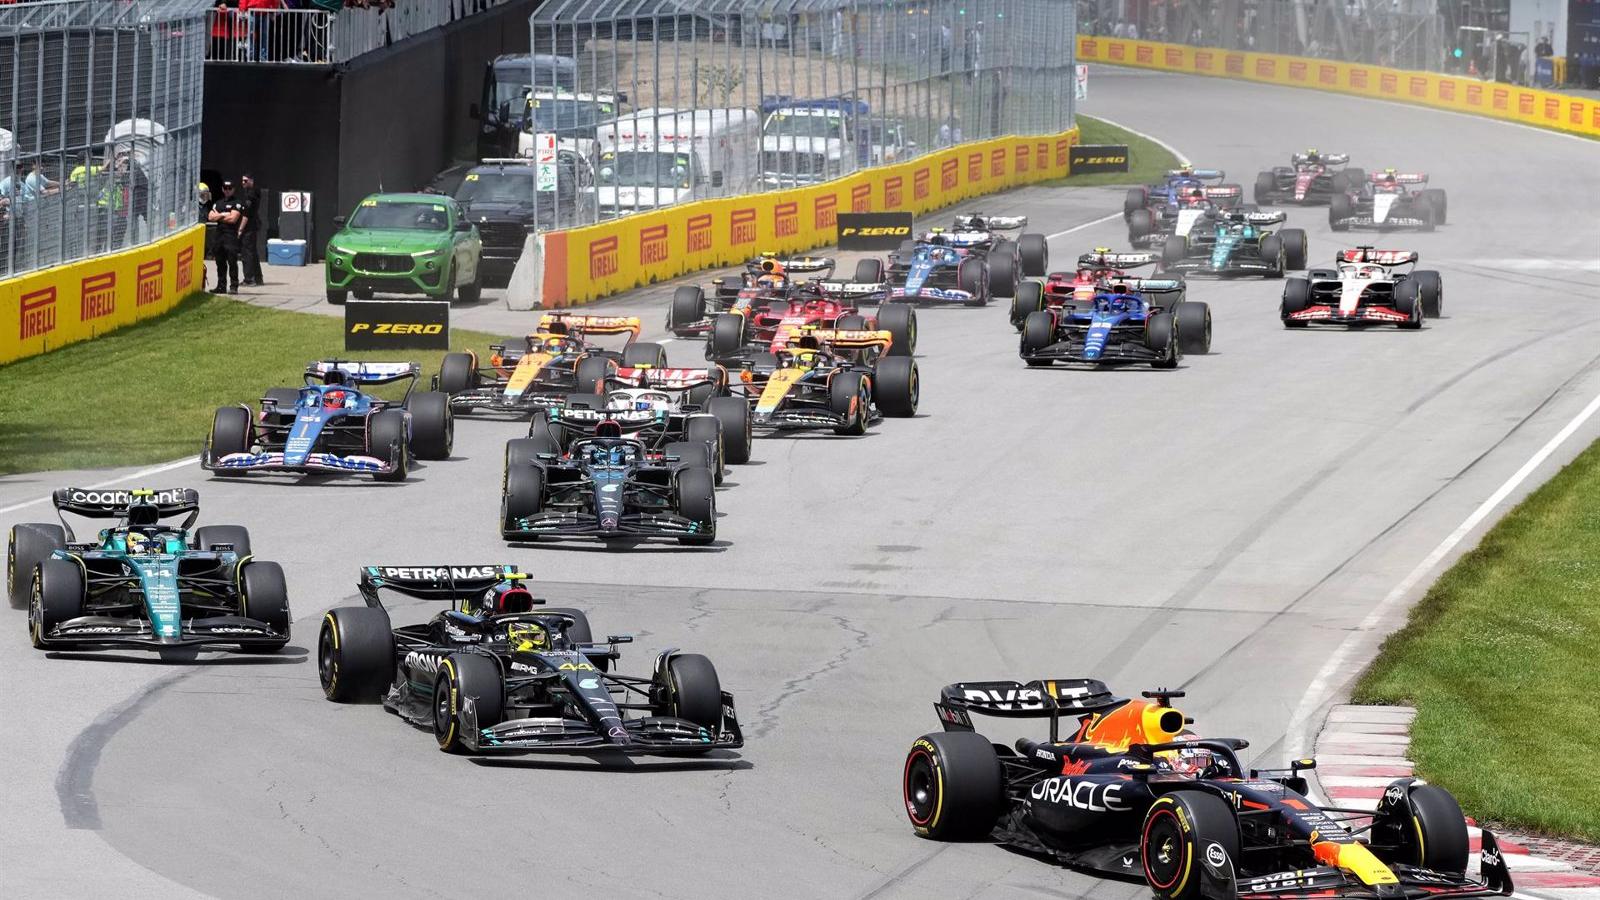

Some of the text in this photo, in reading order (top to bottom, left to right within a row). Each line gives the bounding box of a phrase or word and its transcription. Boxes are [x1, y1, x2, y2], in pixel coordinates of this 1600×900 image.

[687, 214, 712, 253] PIRELLI
[730, 208, 756, 246] PIRELLI
[775, 201, 798, 238] PIRELLI
[842, 227, 909, 237] P ZERO
[590, 236, 618, 280] PIRELLI
[640, 224, 668, 265] PIRELLI
[137, 258, 163, 307] PIRELLI
[176, 245, 193, 293] PIRELLI
[20, 286, 57, 340] PIRELLI
[81, 271, 116, 322] PIRELLI
[351, 323, 443, 334] P ZERO
[385, 566, 495, 580] PETRONAS
[520, 664, 538, 675] AMG
[1031, 778, 1133, 812] ORACLE
[1209, 848, 1225, 861] Esso
